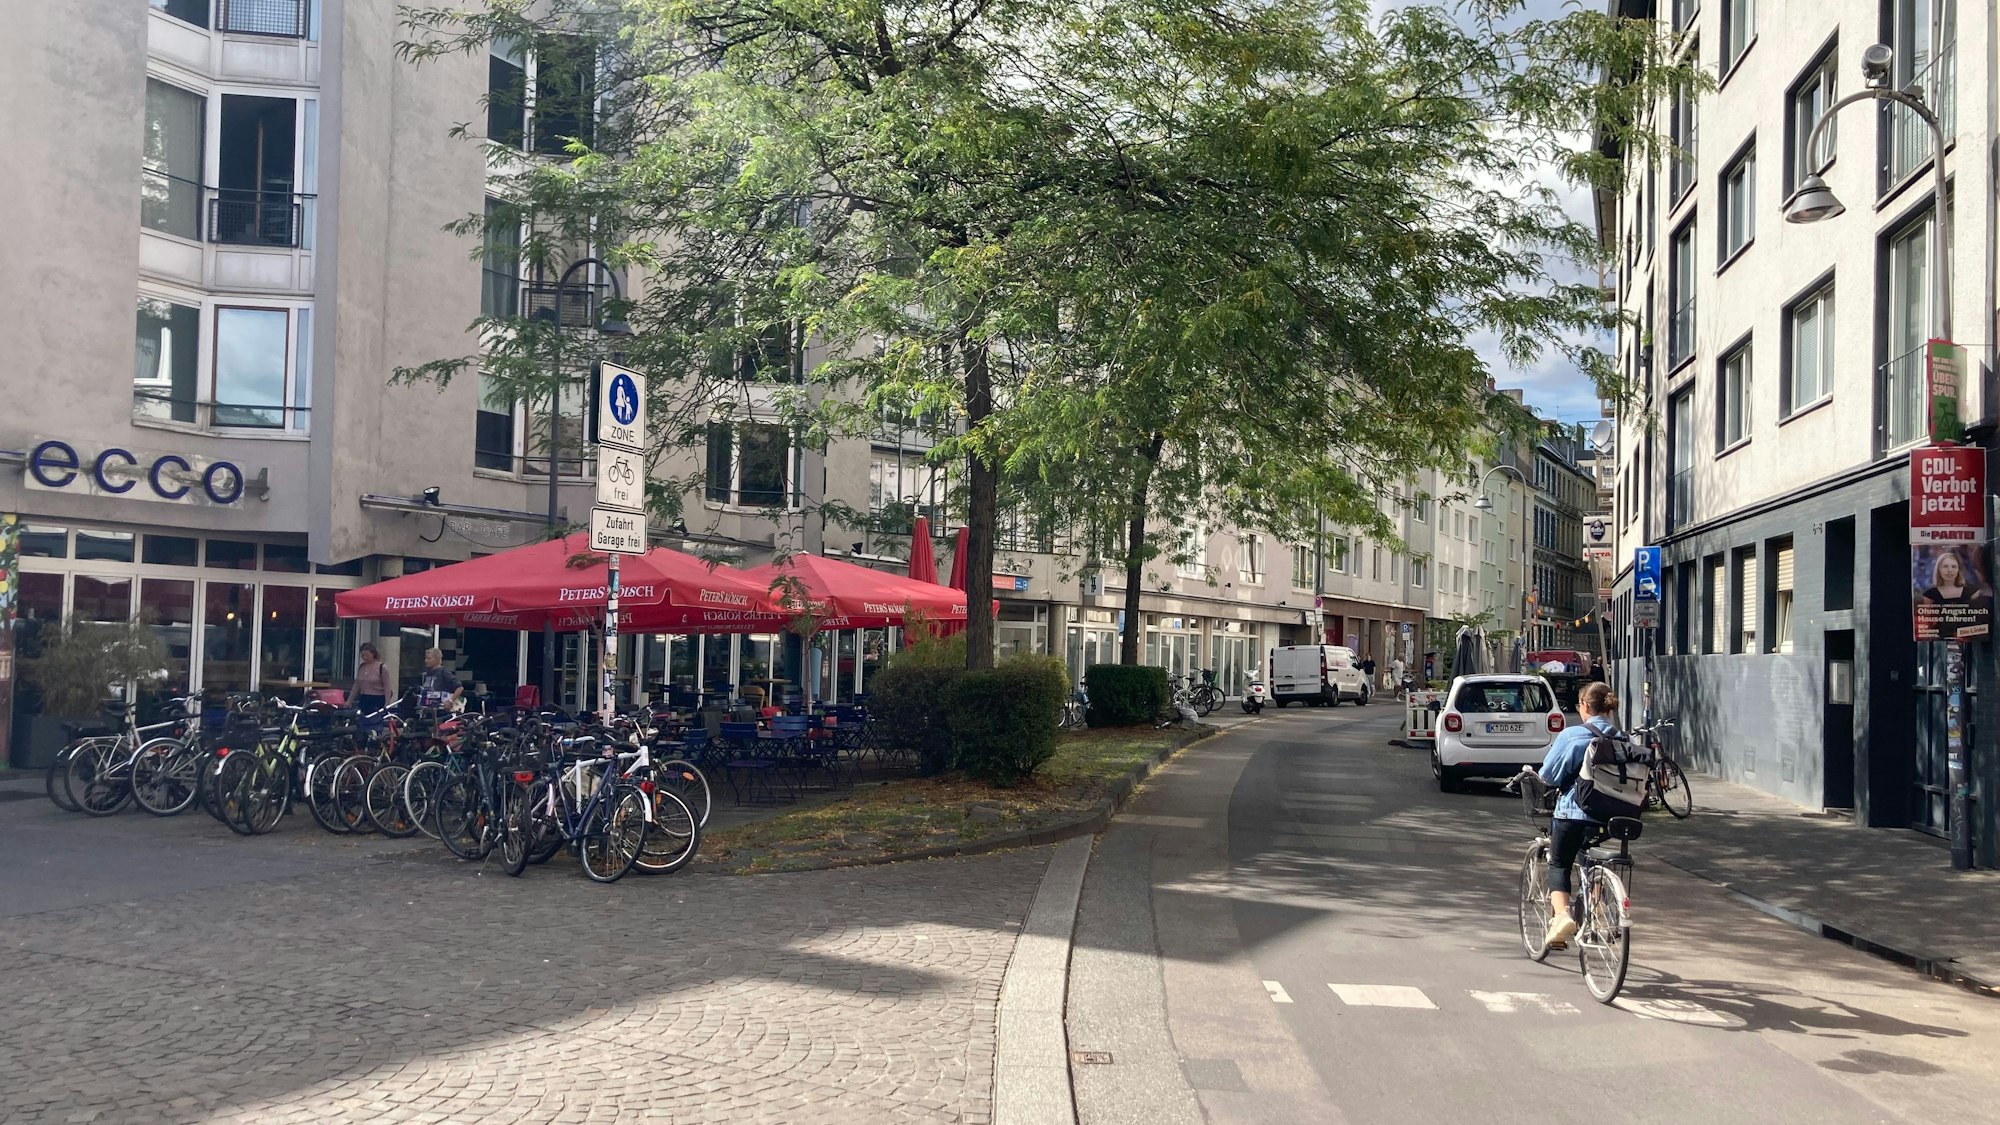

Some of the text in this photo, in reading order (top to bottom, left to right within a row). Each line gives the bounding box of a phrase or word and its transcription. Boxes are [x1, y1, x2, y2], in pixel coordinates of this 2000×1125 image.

[611, 426, 634, 443] ZONE
[31, 441, 244, 504] ecco
[1922, 458, 1962, 475] CDU-
[1921, 476, 1977, 493] Verbot
[614, 487, 629, 501] frei
[1921, 494, 1965, 516] jetzt!
[450, 521, 470, 536] BAR
[606, 516, 634, 531] Zufahrt
[597, 532, 641, 548] Garage frei
[1931, 531, 1975, 540] PARTEI
[617, 584, 655, 598] ÖLSCH
[430, 594, 475, 608] KÖLSCH
[1941, 607, 1966, 616] Angst
[1968, 607, 1989, 615] nach
